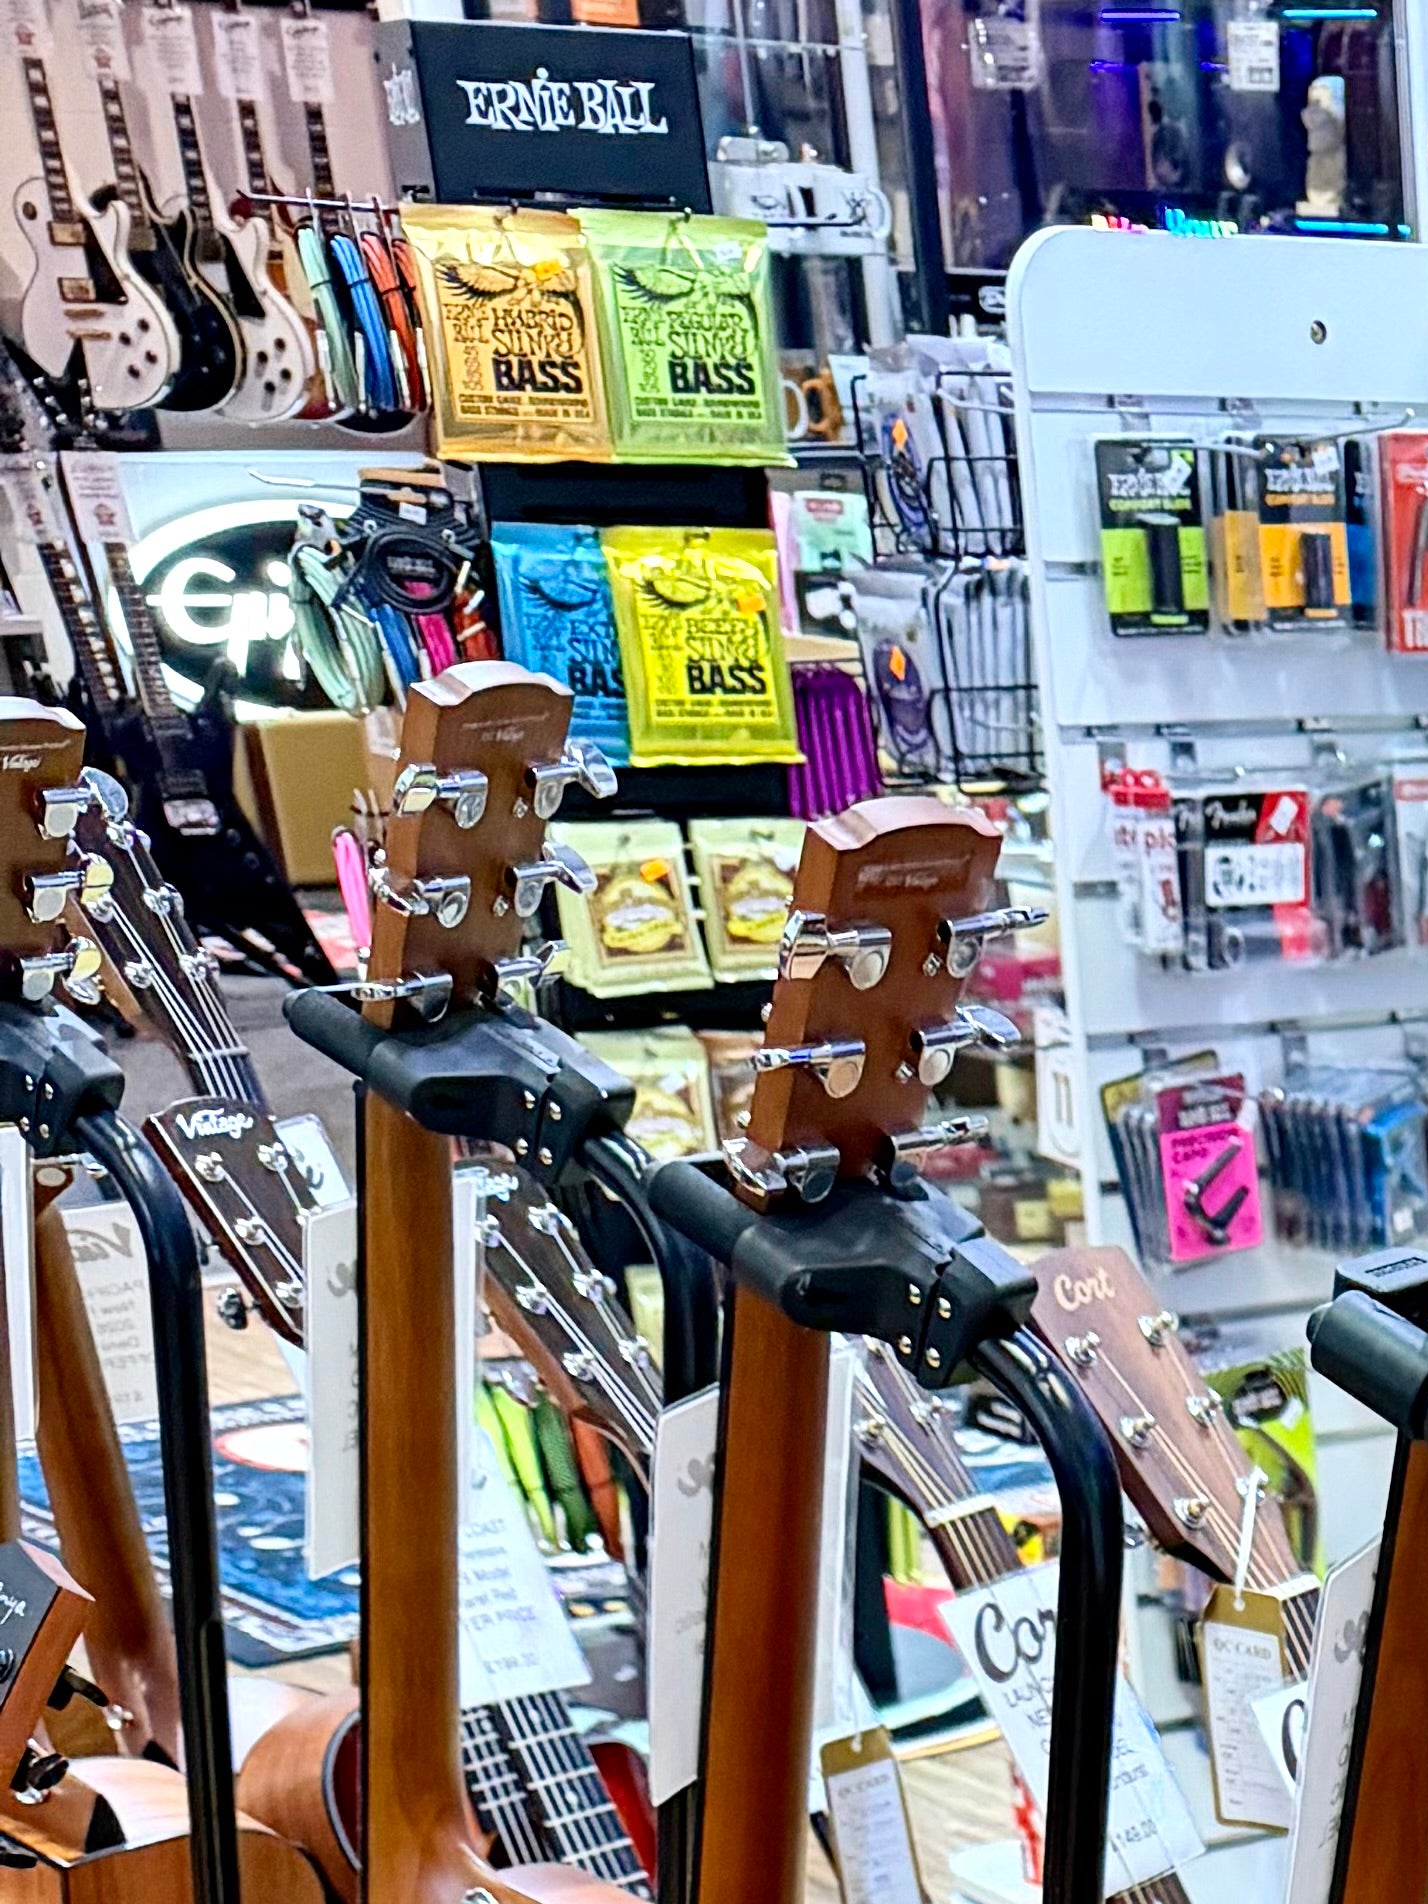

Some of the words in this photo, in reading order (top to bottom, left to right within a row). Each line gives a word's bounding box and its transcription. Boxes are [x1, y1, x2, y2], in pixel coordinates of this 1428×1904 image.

[456, 67, 578, 132] ERNIE
[578, 79, 668, 135] BALL
[491, 308, 573, 331] HYBRID
[492, 329, 573, 357] SLINKY
[668, 329, 748, 359] SLINKY
[493, 357, 582, 393] BASS
[669, 359, 756, 395] BASS
[686, 616, 760, 634] BEEFY
[686, 634, 761, 663] SLINKY
[689, 665, 766, 695] BASS
[175, 1108, 254, 1139] Vintage
[1053, 1268, 1117, 1313] Cort
